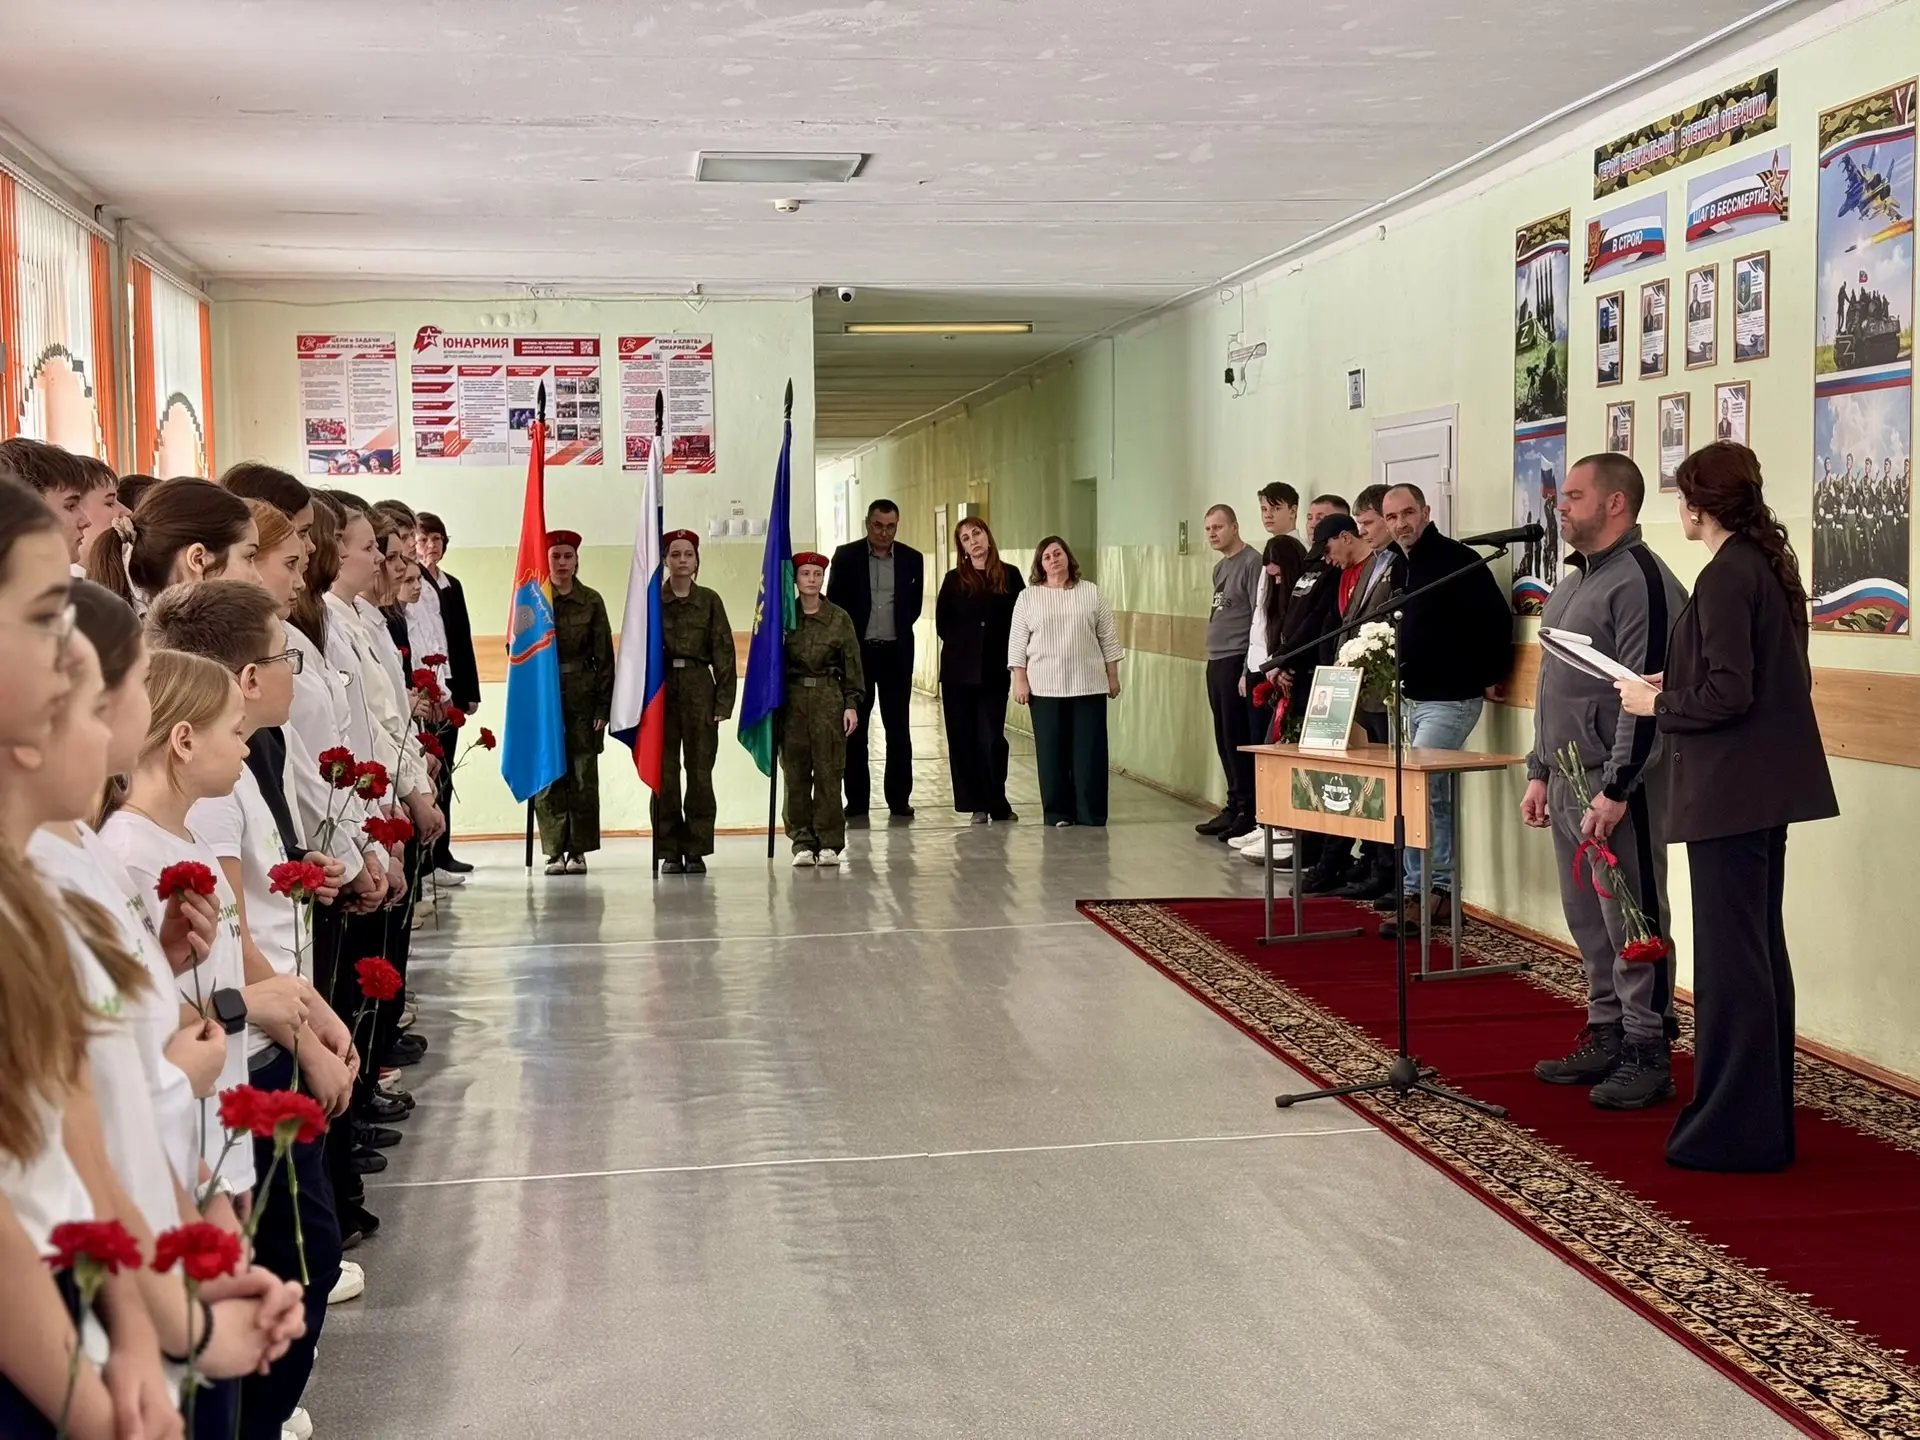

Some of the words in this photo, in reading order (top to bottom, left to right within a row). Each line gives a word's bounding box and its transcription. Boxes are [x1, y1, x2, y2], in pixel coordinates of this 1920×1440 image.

[1620, 130, 1675, 174] СПЕЦИАЛЬНОЙ
[1680, 110, 1719, 149] ВОЕННОЙ
[1719, 92, 1767, 132] ОПЕРАЦИИ
[1692, 208, 1709, 224] ШАГ
[1710, 206, 1716, 219] В
[1717, 187, 1769, 217] БЕССМЕРТИЕ
[1612, 240, 1618, 253] В
[1619, 230, 1643, 251] СТРОЮ
[443, 337, 509, 349] ЮНАРМИЯ
